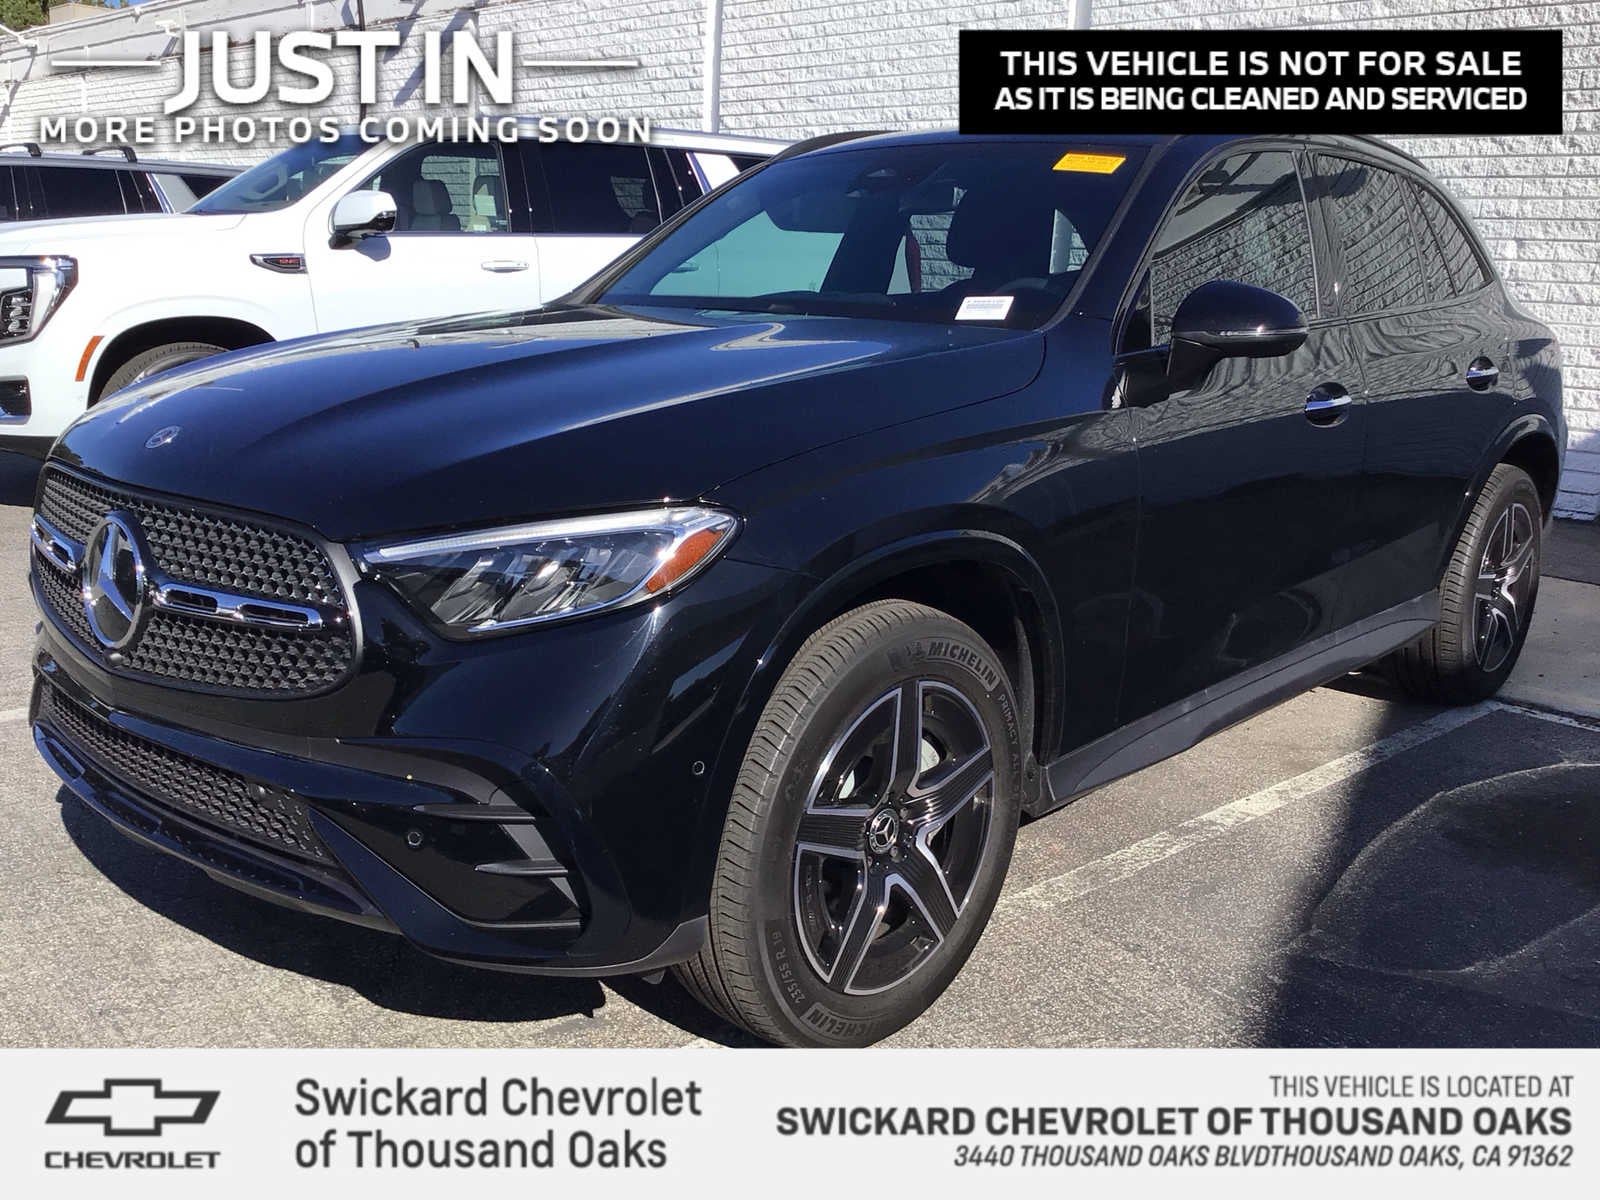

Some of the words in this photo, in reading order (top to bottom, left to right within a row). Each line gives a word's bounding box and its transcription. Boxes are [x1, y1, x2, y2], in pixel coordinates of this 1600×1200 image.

[928, 641, 998, 686] MICHELIN
[998, 693, 1018, 745] PRIMACY
[775, 947, 787, 960] R
[776, 963, 806, 1004] 235/55
